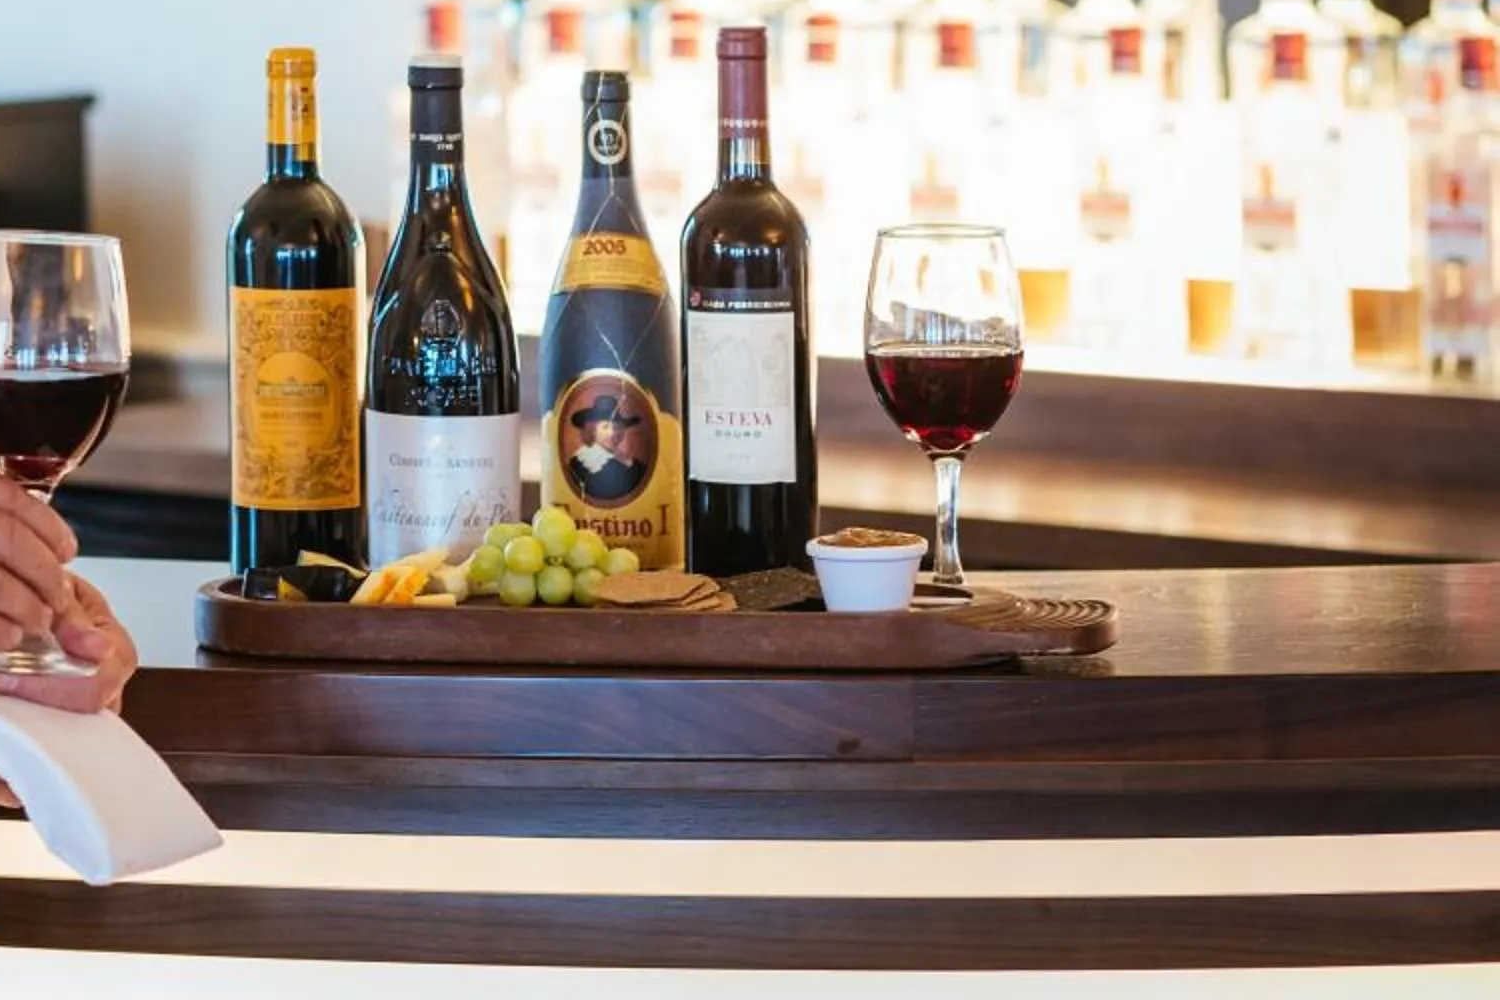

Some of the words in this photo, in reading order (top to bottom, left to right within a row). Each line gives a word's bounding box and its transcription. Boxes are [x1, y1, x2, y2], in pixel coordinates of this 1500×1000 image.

[583, 239, 626, 256] 2005
[705, 410, 772, 426] ESTEVA
[554, 502, 653, 539] ustino
[657, 503, 670, 536] I
